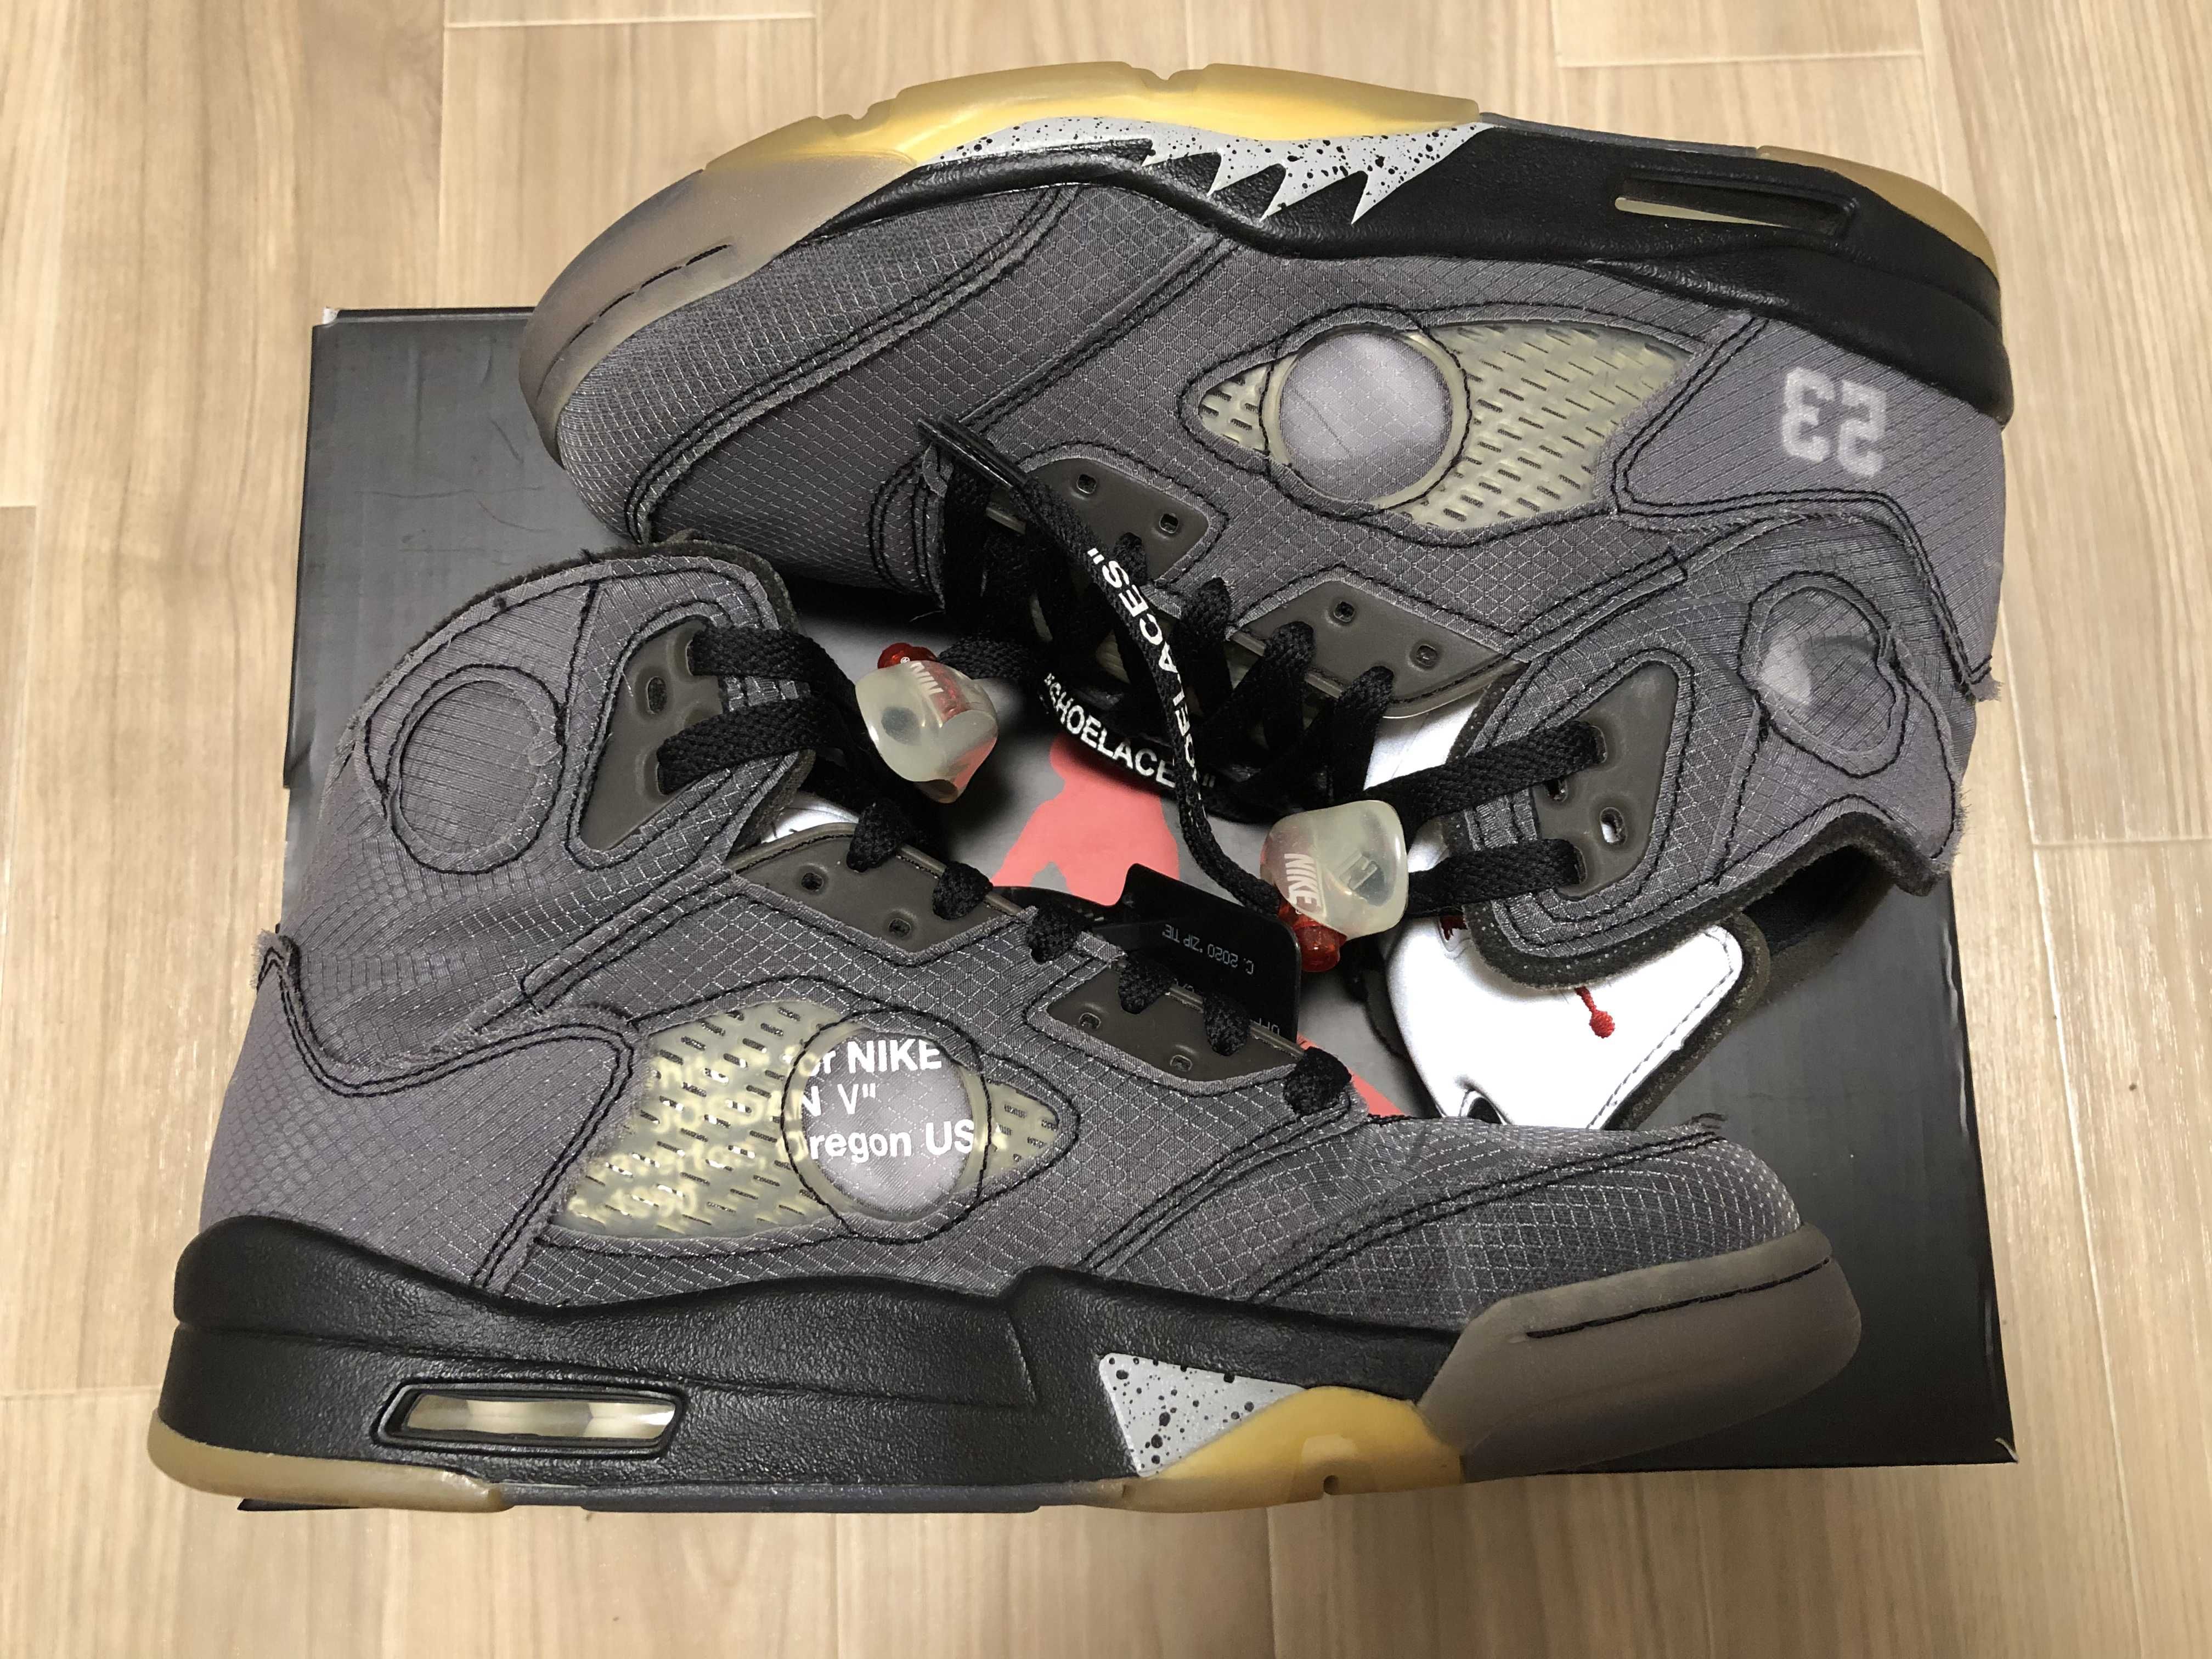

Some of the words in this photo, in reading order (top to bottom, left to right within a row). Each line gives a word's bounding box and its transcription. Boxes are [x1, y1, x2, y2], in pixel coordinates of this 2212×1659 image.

[1781, 366, 1887, 478] 23
[1284, 853, 1321, 905] NIKE
[1207, 944, 1238, 968] 2020
[847, 1038, 942, 1074] NIKE
